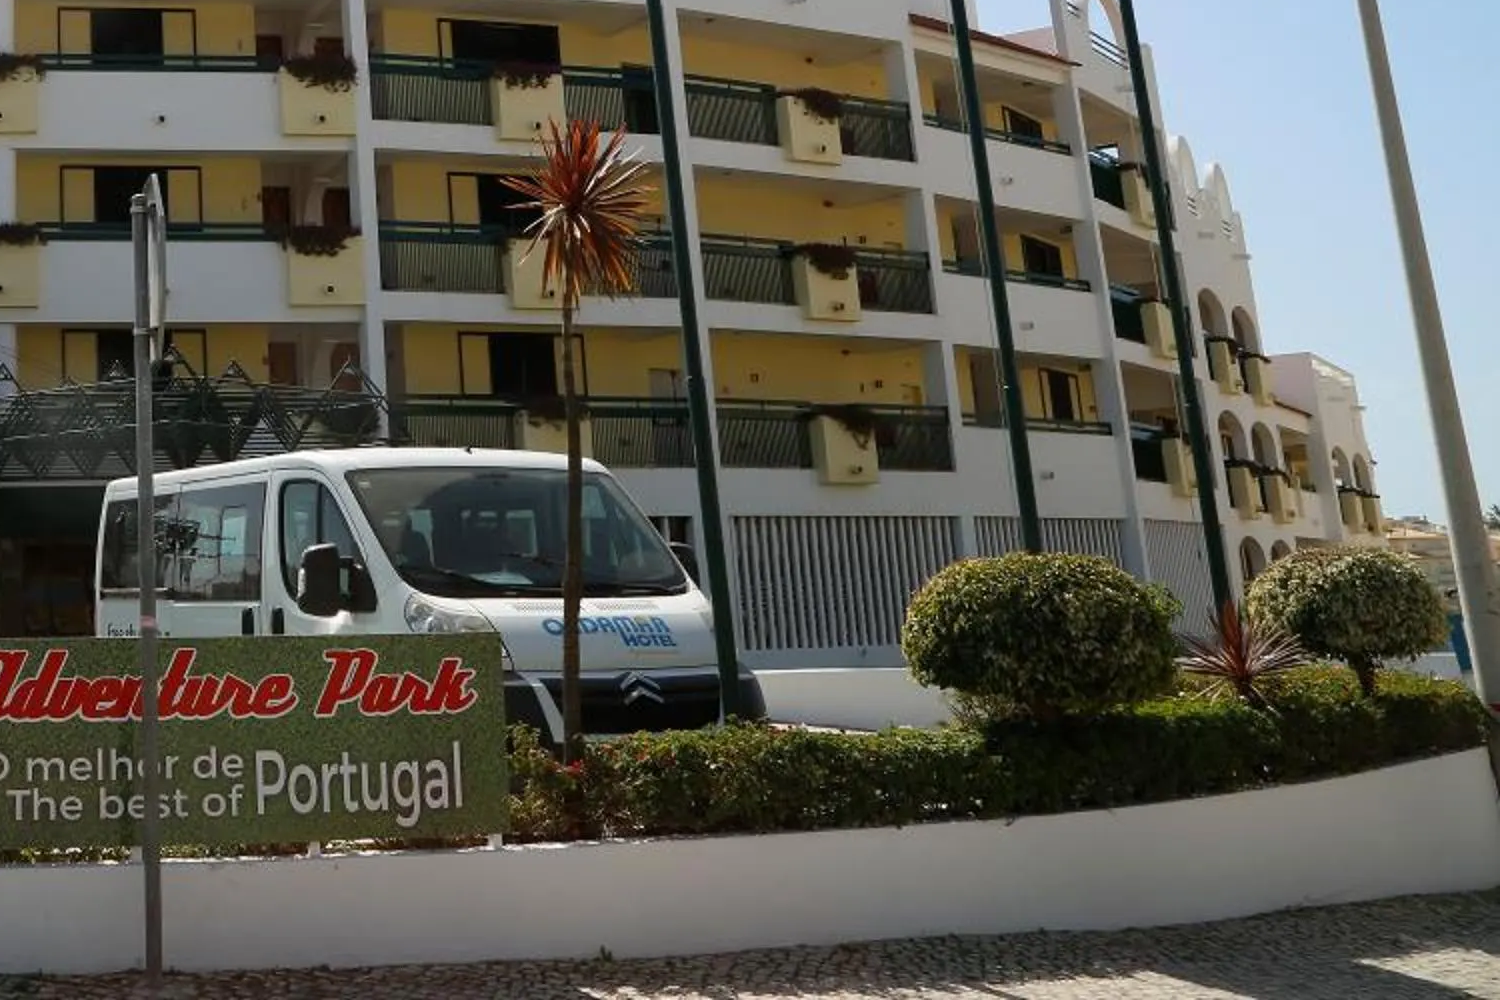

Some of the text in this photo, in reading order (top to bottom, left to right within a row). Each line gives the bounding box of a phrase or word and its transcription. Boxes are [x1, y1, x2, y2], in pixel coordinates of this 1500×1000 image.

[542, 616, 671, 637] ODAMAR
[621, 633, 677, 647] HOTEL
[313, 648, 478, 718] Park
[193, 747, 244, 779] de
[6, 788, 83, 821] The
[202, 784, 244, 817] of
[255, 741, 463, 828] Portugal
